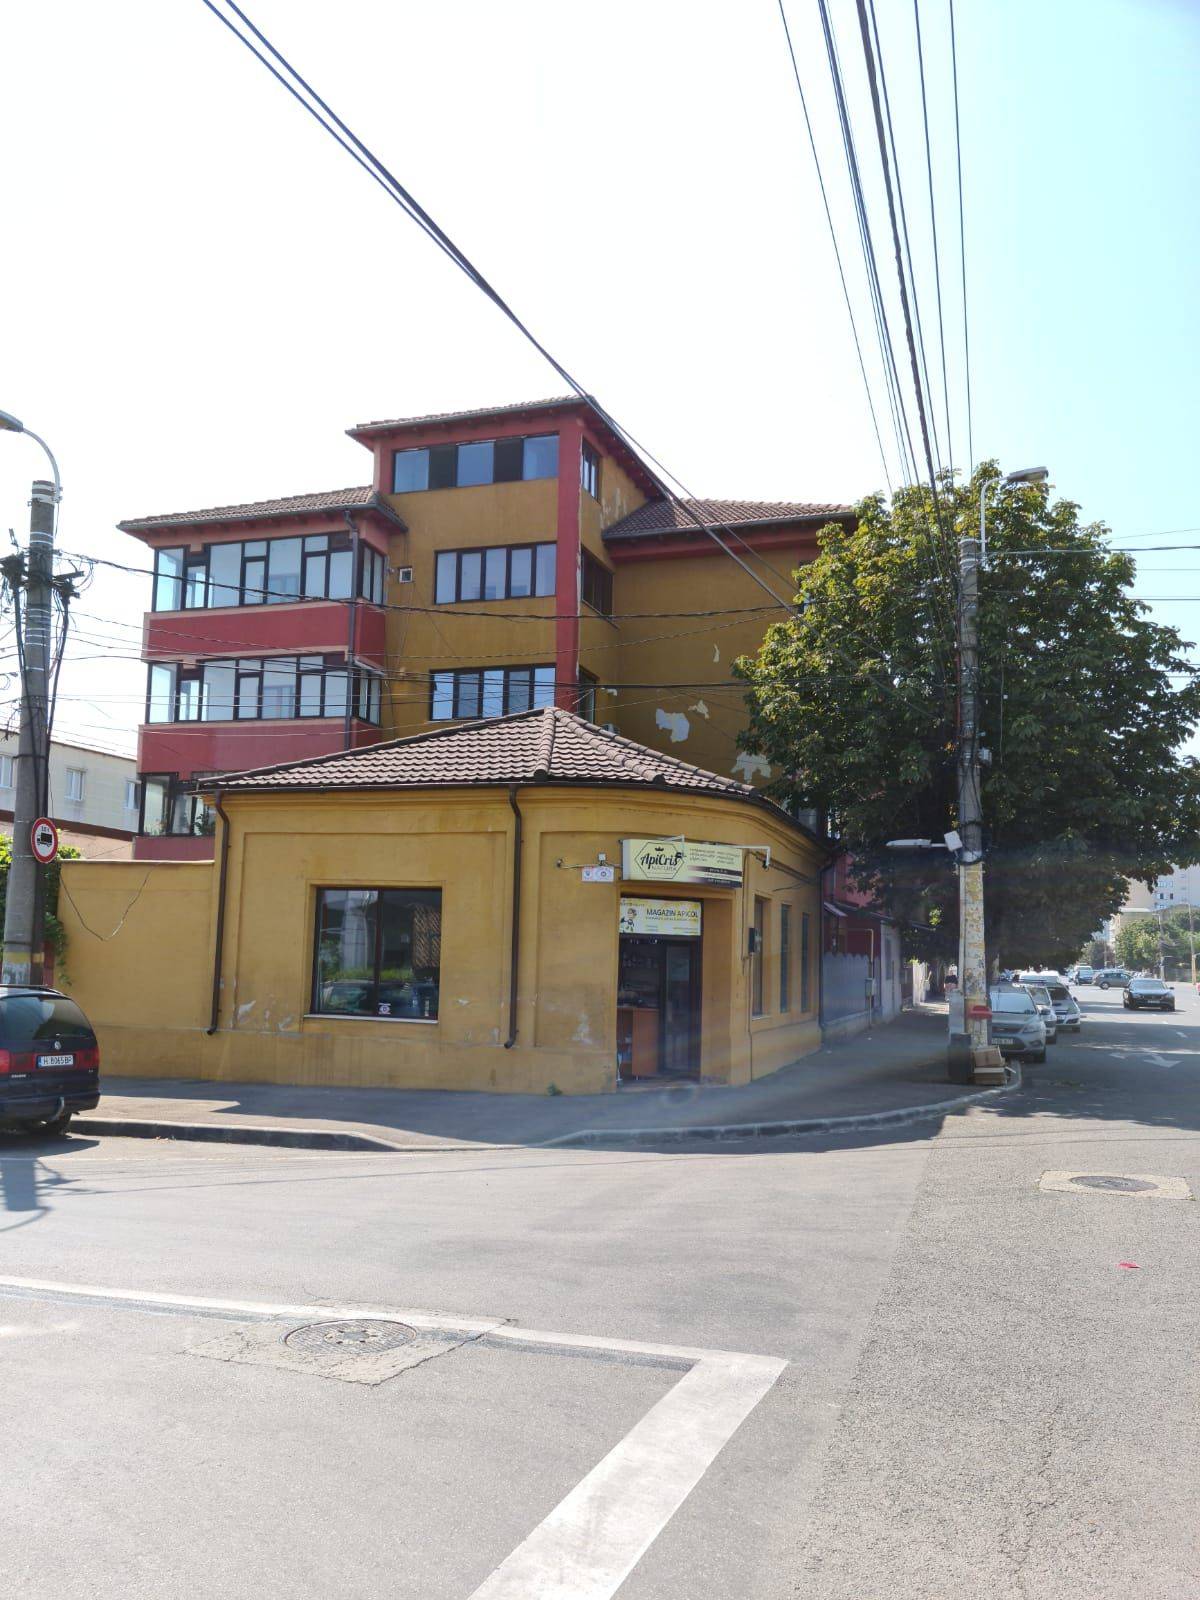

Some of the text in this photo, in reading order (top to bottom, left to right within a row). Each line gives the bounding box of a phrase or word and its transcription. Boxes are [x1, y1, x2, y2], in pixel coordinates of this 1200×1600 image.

[640, 853, 678, 869] ApiCris
[646, 908, 698, 918] MAGAZIN APICOL
